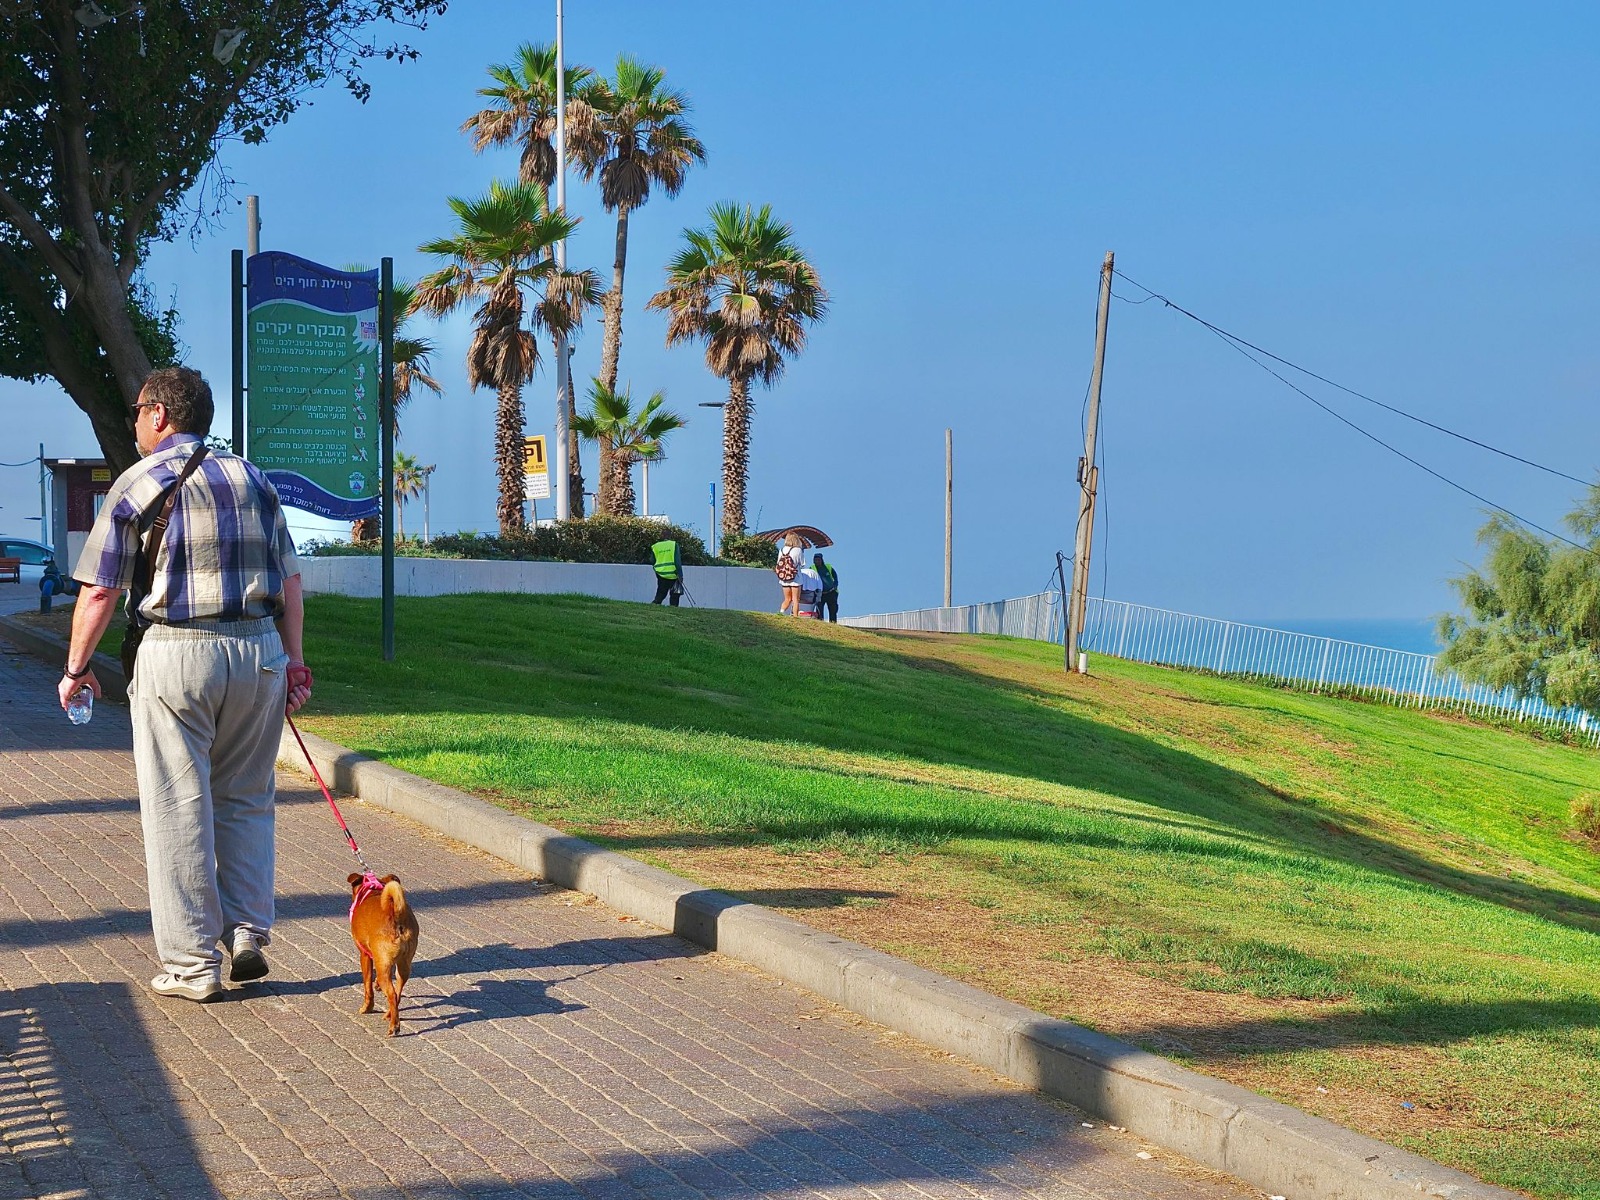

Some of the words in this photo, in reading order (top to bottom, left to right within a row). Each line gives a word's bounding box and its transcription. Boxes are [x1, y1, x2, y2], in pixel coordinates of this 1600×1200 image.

[276, 276, 294, 286] הים
[298, 278, 318, 288] חוף
[322, 279, 352, 289] טיילת
[256, 322, 291, 336] יקרים
[296, 323, 346, 337] מבקרים
[314, 340, 334, 348] שלכם
[256, 346, 280, 354] מתקניו
[282, 347, 304, 355] שלמות
[305, 348, 317, 356] ועל
[257, 364, 271, 372] לפח
[273, 365, 299, 373] הפסולת
[313, 366, 337, 374] להשליך
[324, 388, 347, 396] הבערת
[272, 403, 288, 411] לרכב
[290, 404, 300, 412] הגן
[302, 404, 321, 412] לשטח
[256, 426, 266, 434] לגן
[314, 428, 336, 436] להכניס
[337, 429, 347, 437] אין
[324, 450, 347, 458] ורצועה
[275, 456, 286, 464] של
[288, 456, 303, 464] גלליו
[316, 457, 337, 465] לאסוף
[276, 483, 292, 491] מפגע
[292, 486, 304, 494] לכל
[292, 496, 314, 508] למוקד
